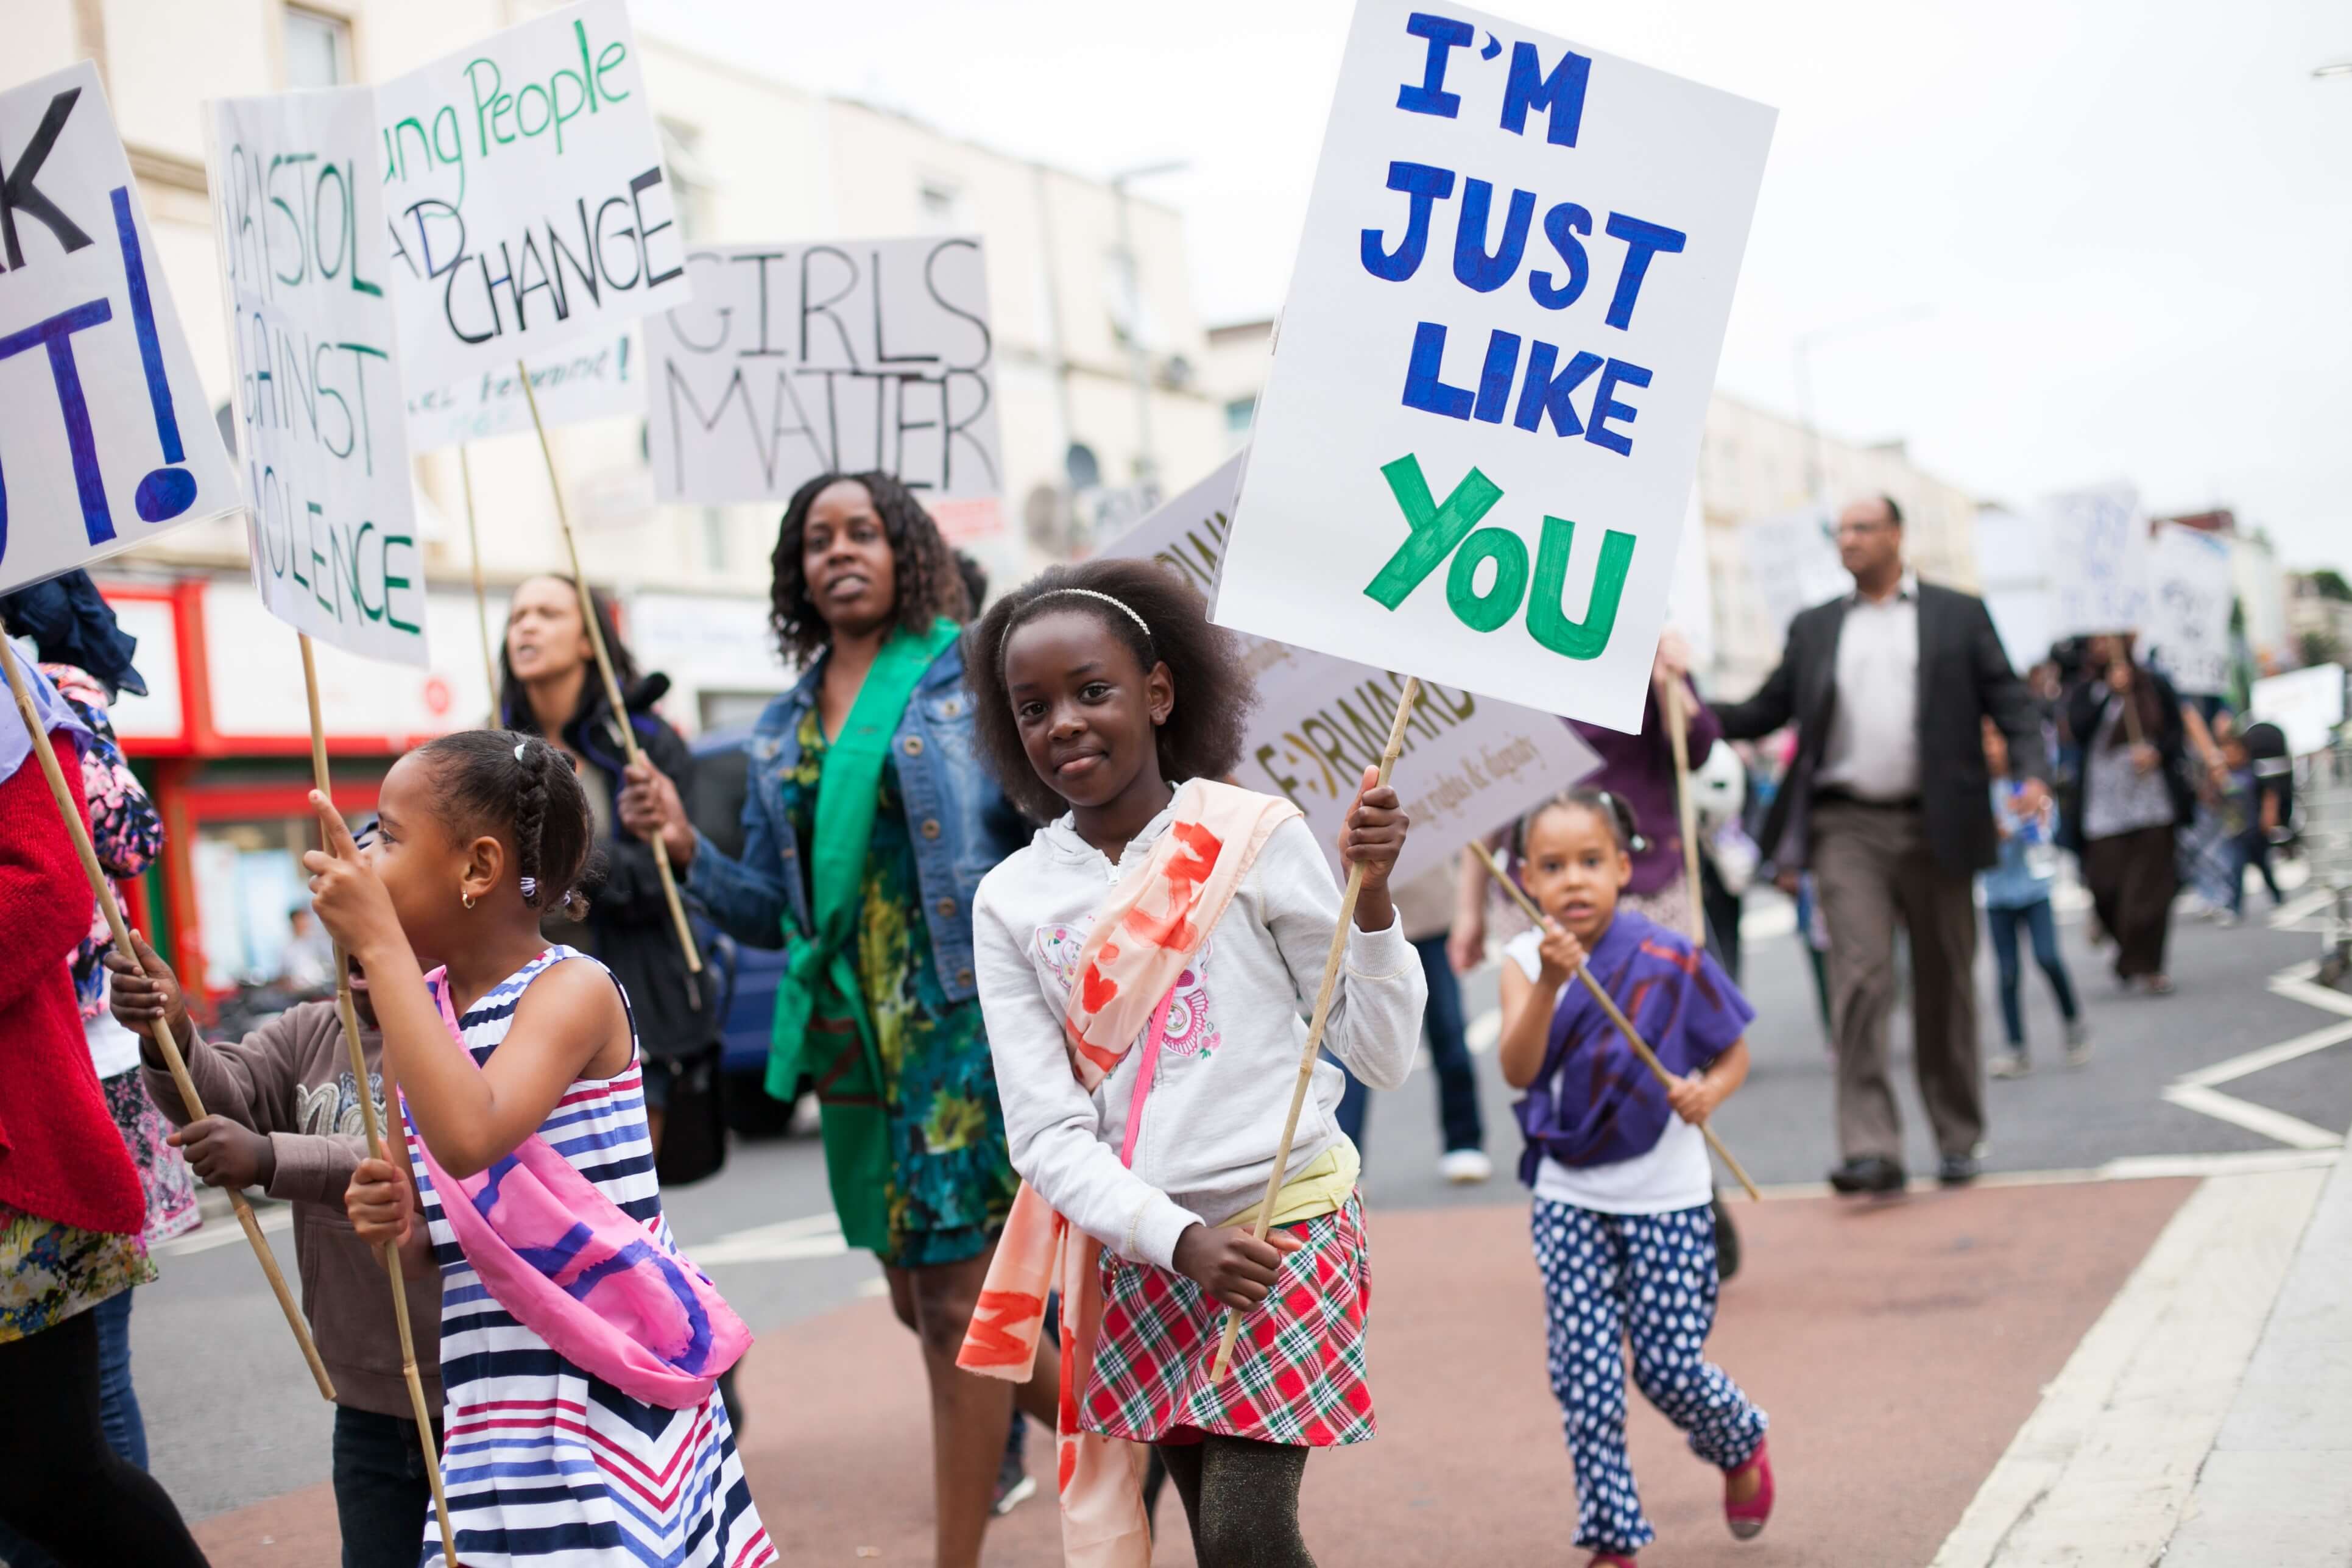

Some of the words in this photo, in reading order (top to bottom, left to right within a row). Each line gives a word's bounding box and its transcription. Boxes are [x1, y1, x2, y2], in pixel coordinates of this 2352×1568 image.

[463, 19, 631, 157] People
[1396, 12, 1592, 148] I'M
[227, 143, 384, 305] RISTOL
[445, 166, 685, 345] CHANGE
[1360, 161, 1687, 331] JUST
[665, 239, 991, 370] GIRLS
[665, 358, 1001, 491] MATTER
[1402, 321, 1653, 457] LIKE
[250, 460, 421, 637] IOLENCE
